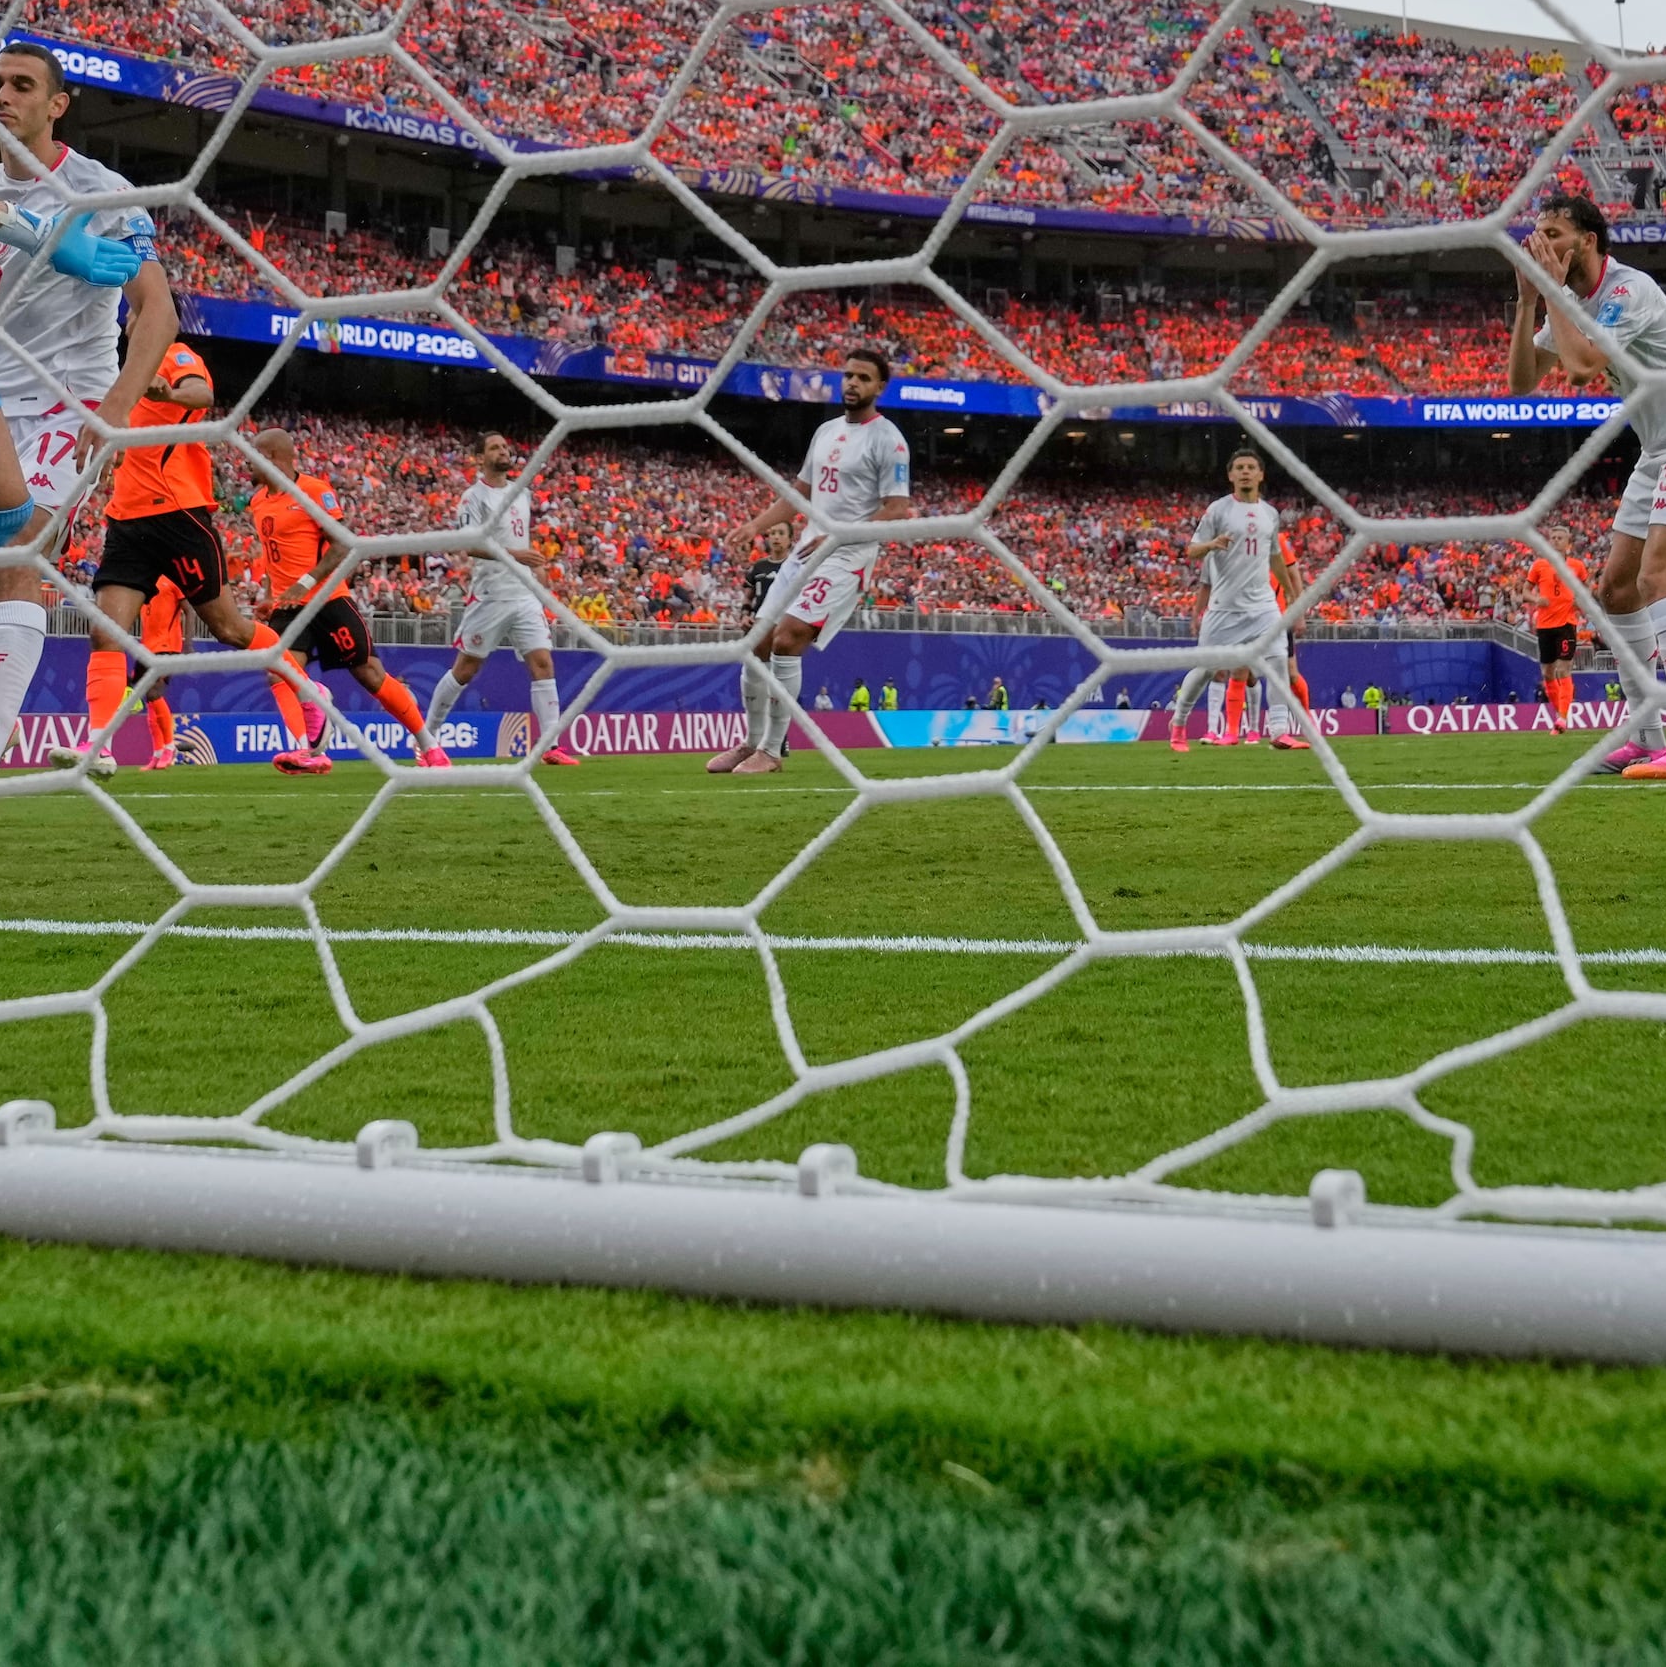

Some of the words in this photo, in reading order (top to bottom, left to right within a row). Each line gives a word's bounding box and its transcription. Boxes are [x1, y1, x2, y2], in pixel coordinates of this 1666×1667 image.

[379, 328, 416, 352] CUP
[416, 333, 478, 360] 2026
[1424, 403, 1466, 421] FIFA
[1466, 403, 1533, 421] WORLD
[1535, 403, 1574, 420] CUP
[37, 430, 78, 468] 17
[818, 466, 839, 493] 25
[511, 518, 525, 538] 13
[1245, 537, 1257, 556] 11
[172, 556, 205, 586] 14
[802, 576, 833, 605] 25
[1554, 584, 1561, 597] 6
[329, 626, 356, 652] 18
[1561, 639, 1569, 653] 6
[1407, 702, 1521, 731] QATAR
[236, 722, 281, 752] FIFA
[365, 722, 403, 749] CUP
[570, 713, 669, 755] QATAR
